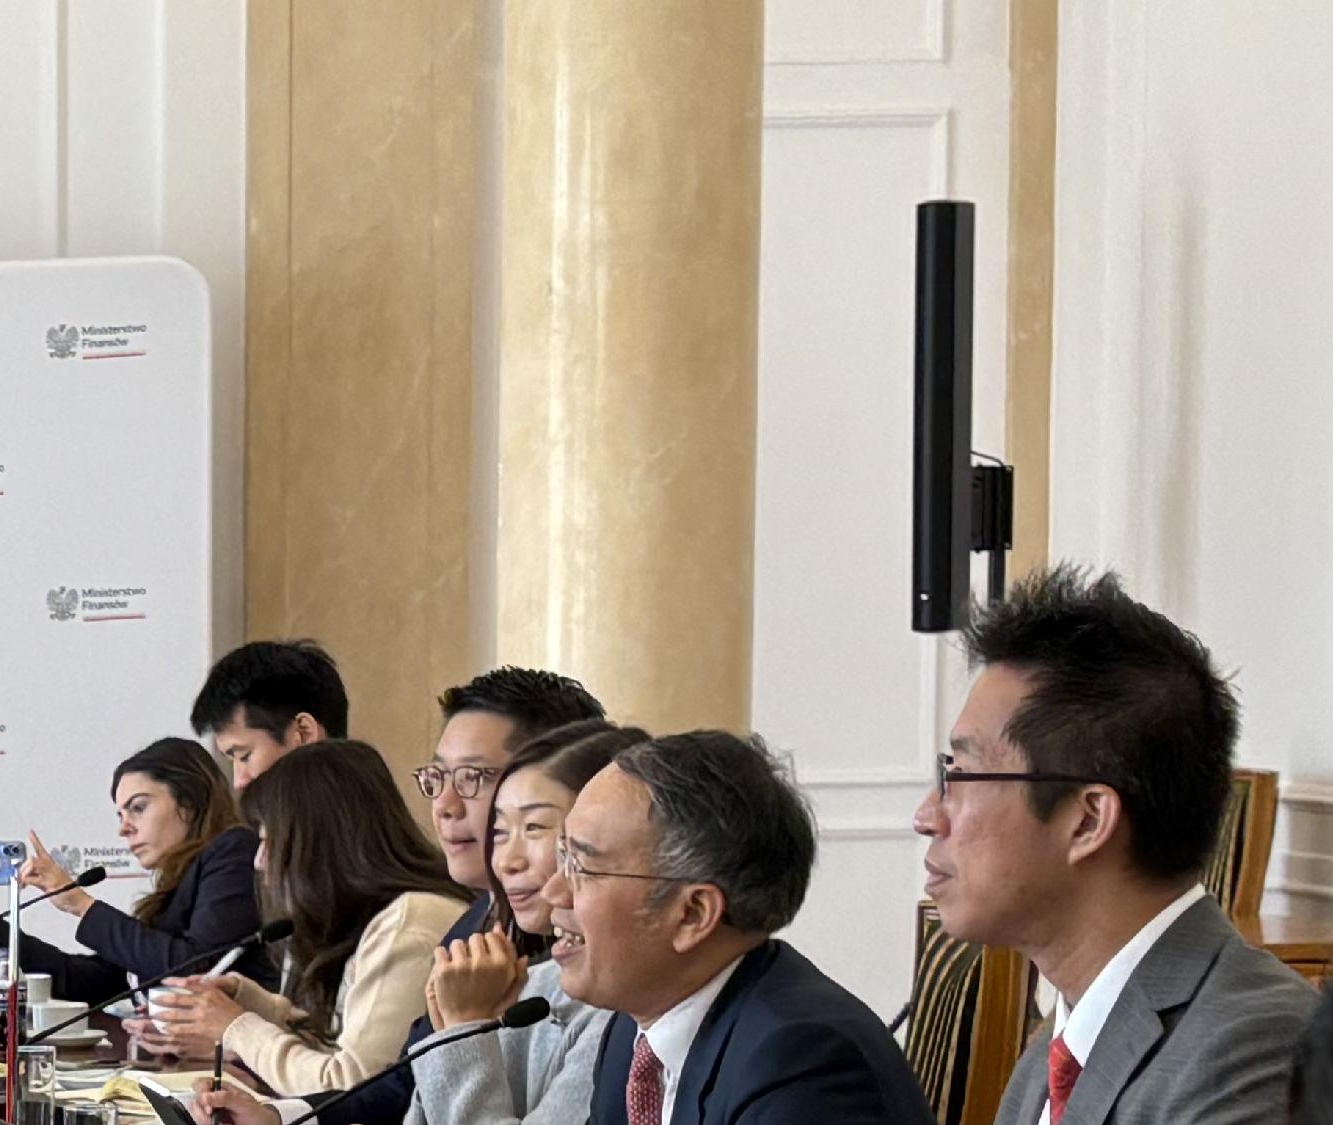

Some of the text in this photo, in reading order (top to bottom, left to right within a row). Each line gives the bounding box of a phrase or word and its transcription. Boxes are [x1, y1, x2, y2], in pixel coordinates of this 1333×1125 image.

[80, 324, 147, 336] Ministerstwo
[81, 337, 129, 348] Finansów
[81, 587, 147, 598] Ministerstwo
[81, 600, 129, 611] Finansów
